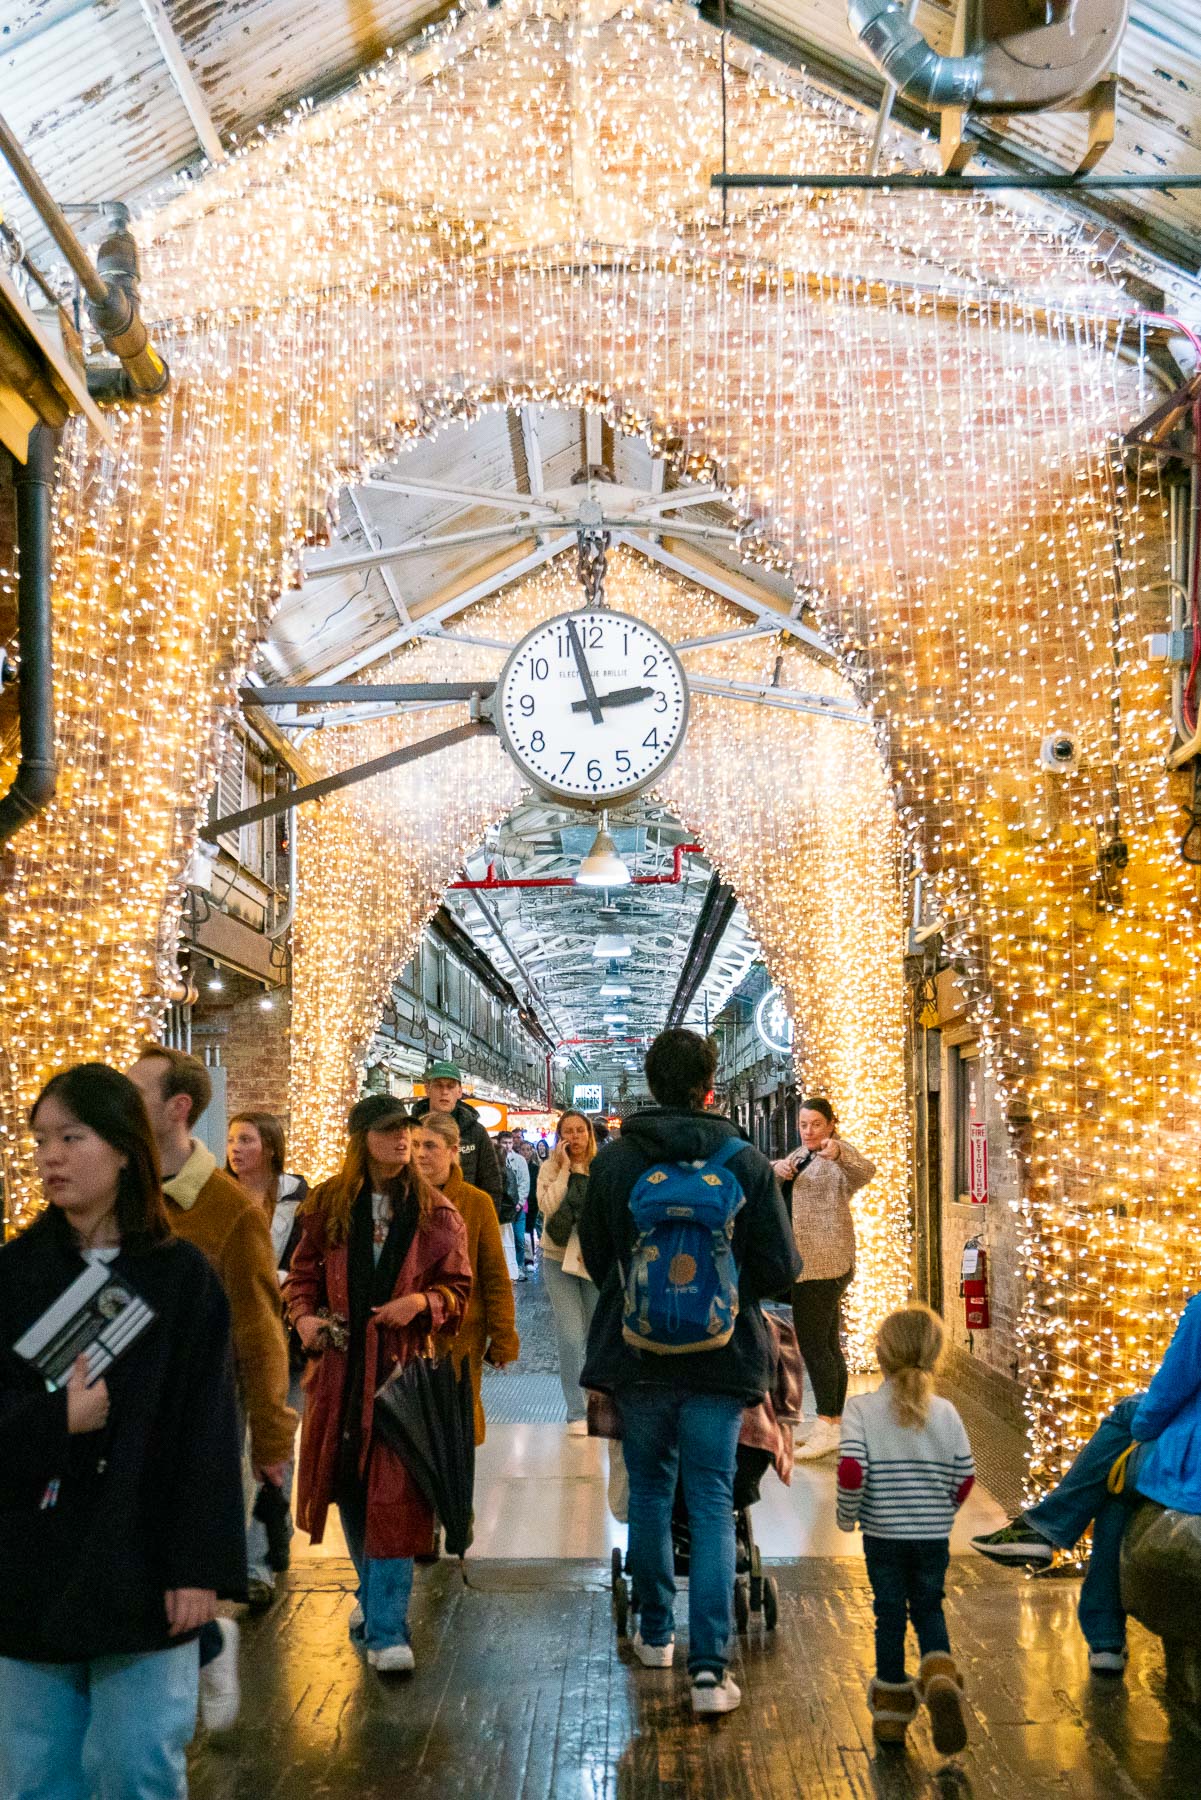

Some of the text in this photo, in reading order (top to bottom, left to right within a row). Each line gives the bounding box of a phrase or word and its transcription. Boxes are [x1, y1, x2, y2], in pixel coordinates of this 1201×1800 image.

[558, 635, 570, 658] 11
[582, 626, 604, 649] 12
[624, 633, 629, 656] 1
[531, 658, 549, 680] 10
[559, 670, 599, 678] ELECTUE
[643, 655, 658, 678] 2
[520, 695, 535, 717] 9
[654, 691, 668, 713] 3
[531, 731, 546, 753] 8
[642, 727, 660, 750] 4
[560, 752, 575, 775] 7
[587, 760, 602, 782] 6
[616, 750, 631, 773] 5
